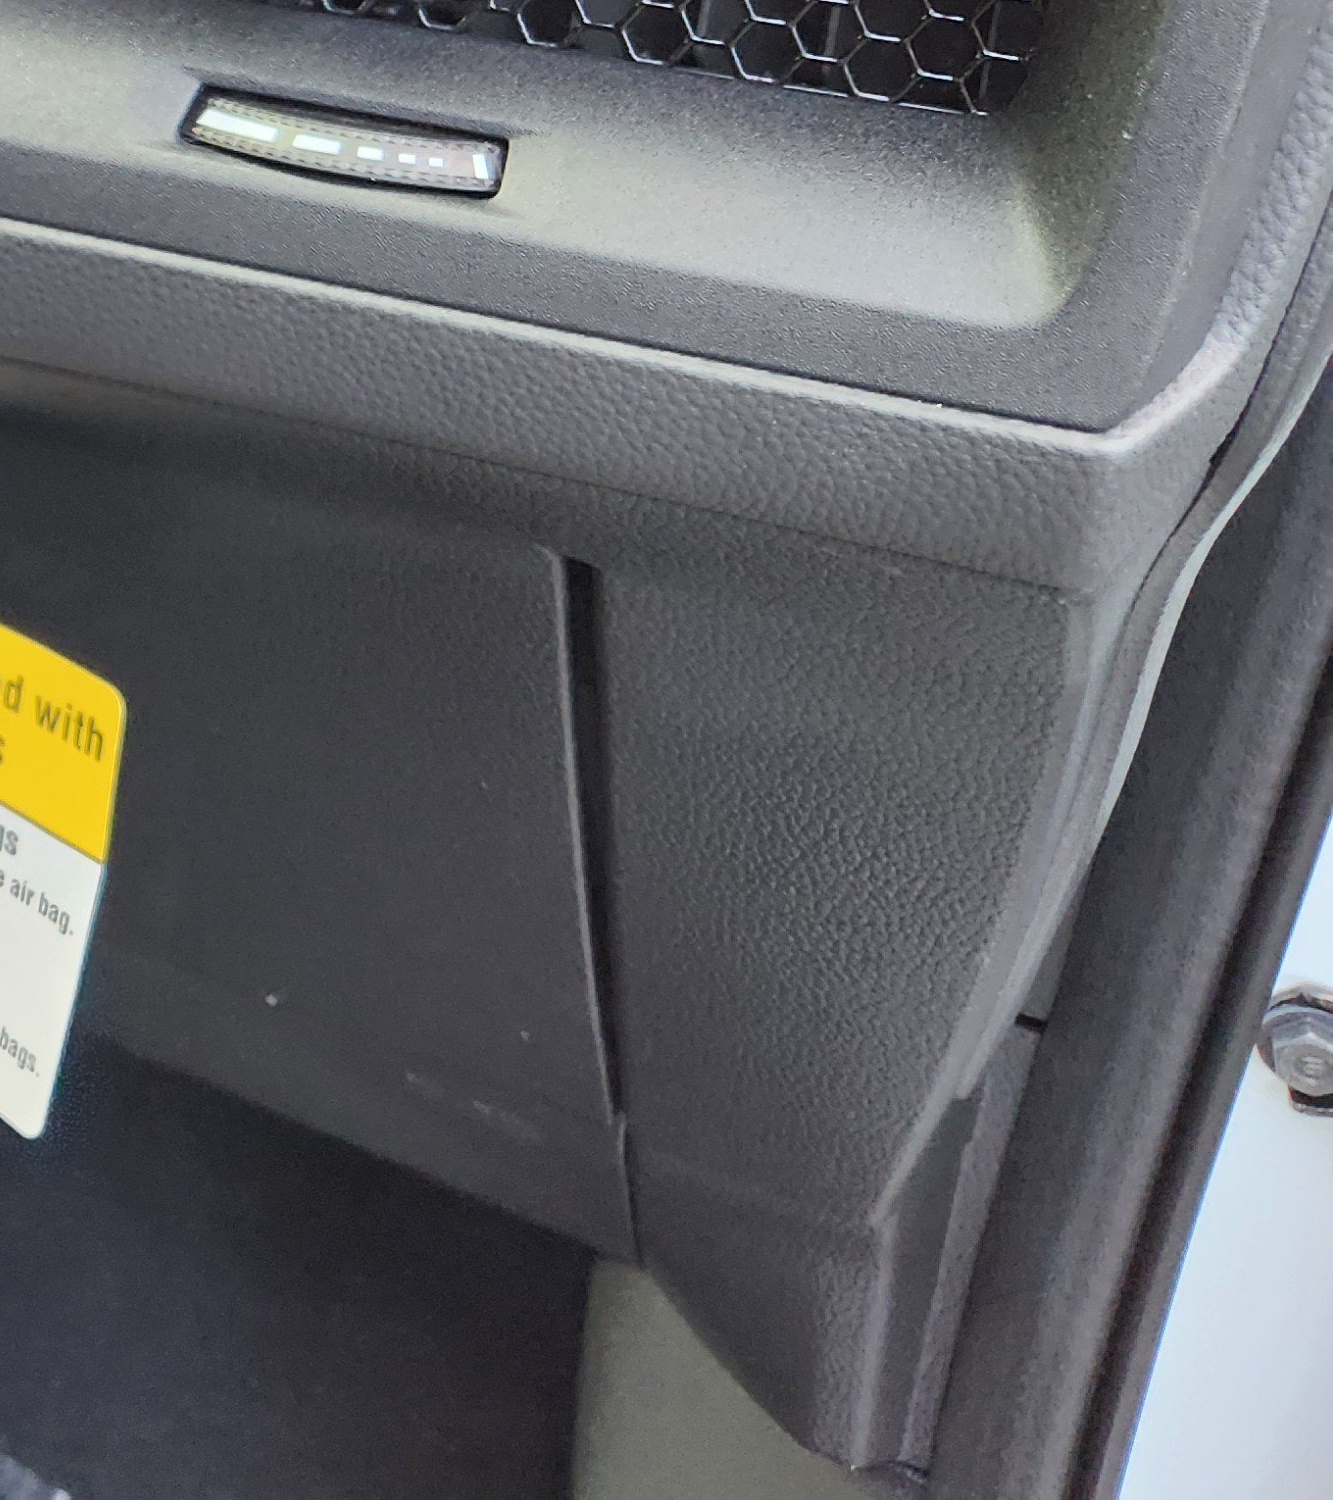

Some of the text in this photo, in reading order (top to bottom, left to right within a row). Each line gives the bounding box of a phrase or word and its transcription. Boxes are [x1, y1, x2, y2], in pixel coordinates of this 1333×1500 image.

[36, 695, 104, 762] with
[10, 877, 34, 906] air
[37, 891, 74, 935] bag.
